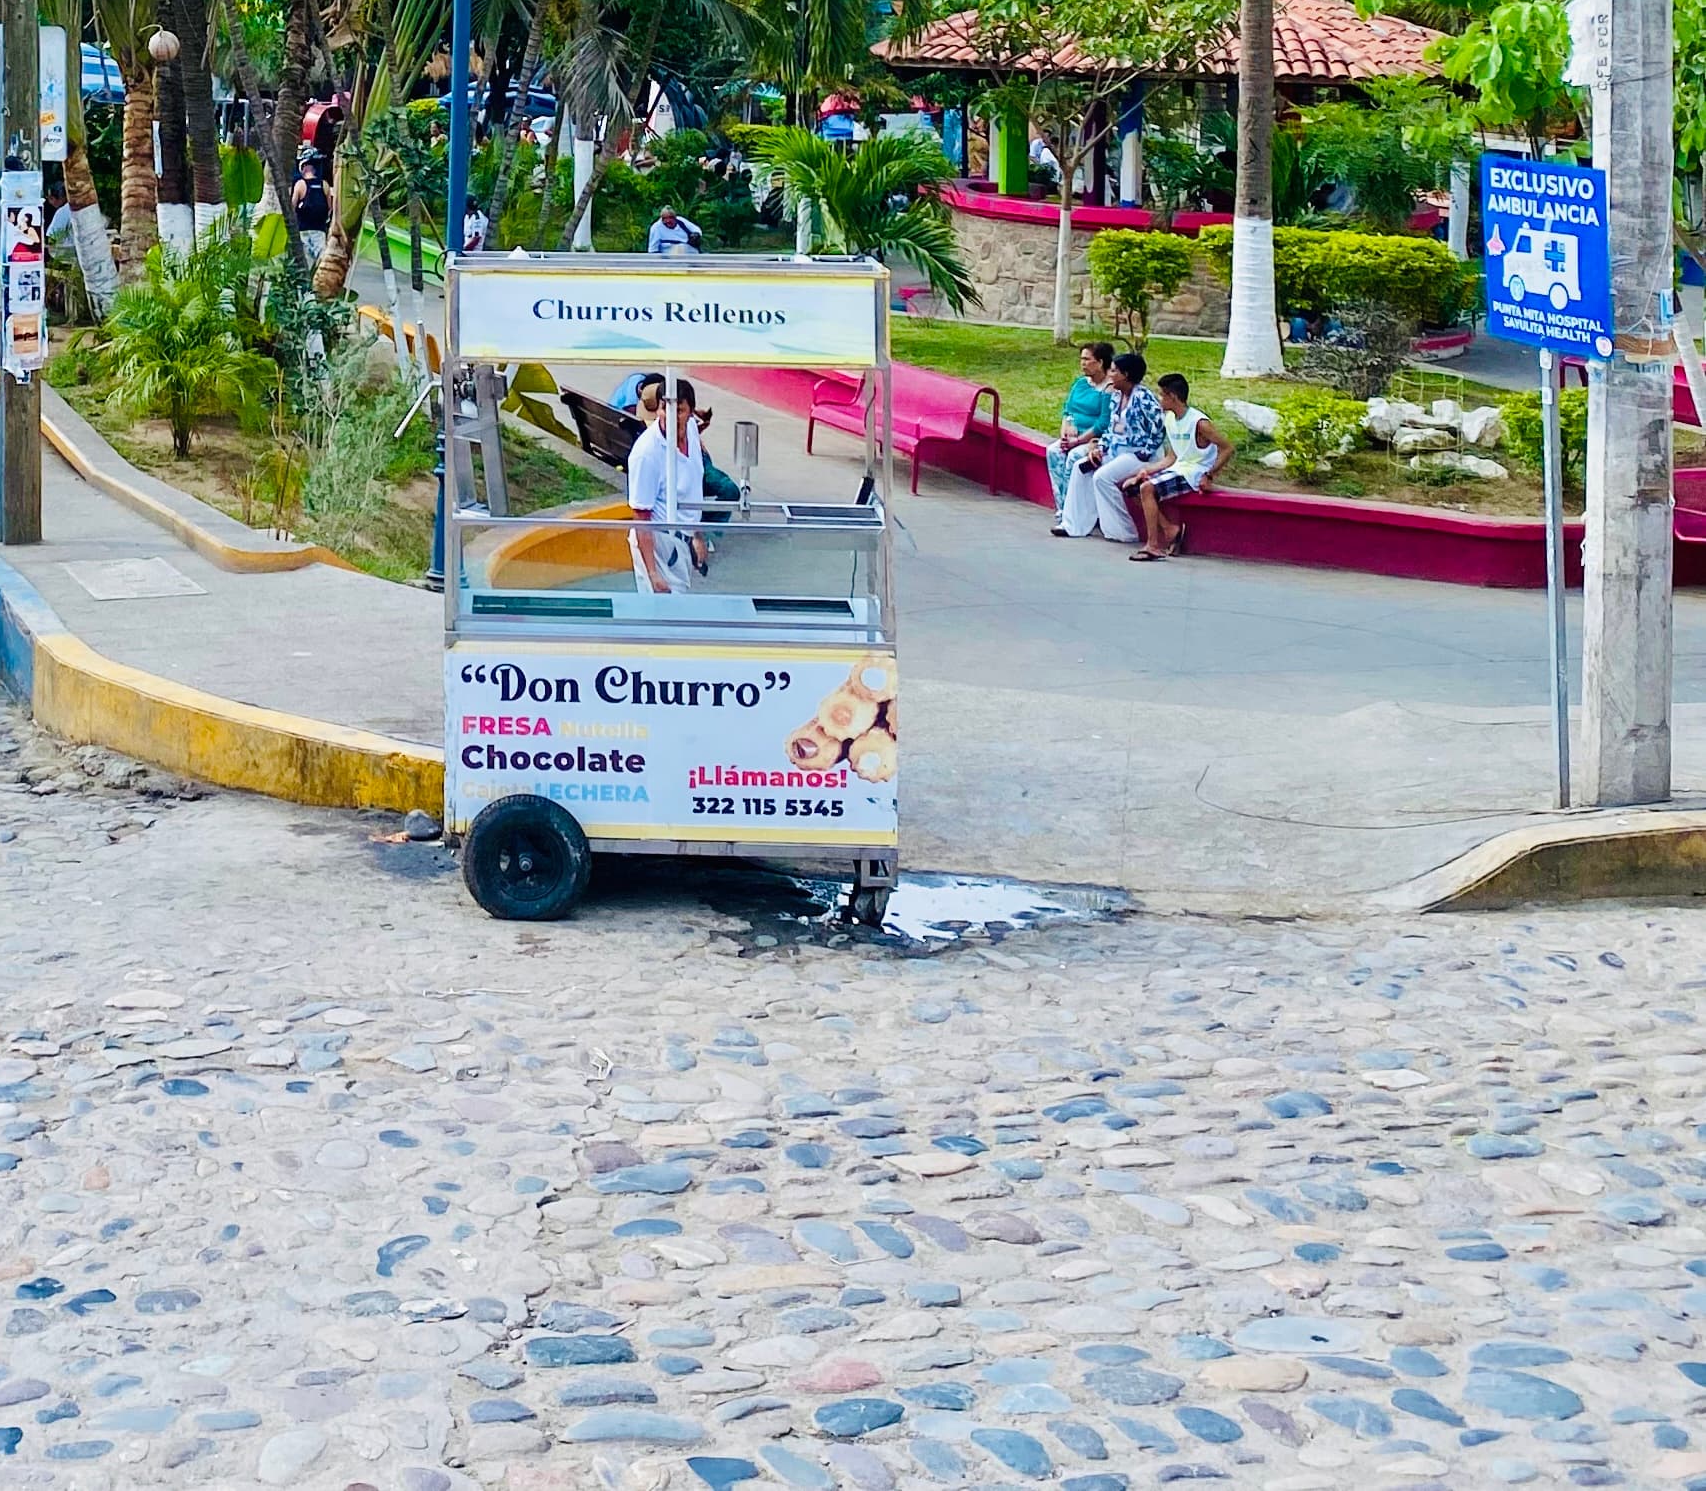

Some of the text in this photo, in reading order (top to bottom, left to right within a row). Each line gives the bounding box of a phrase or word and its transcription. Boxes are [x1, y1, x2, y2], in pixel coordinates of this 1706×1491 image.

[1489, 167, 1595, 200] EXCLUSIVO
[1487, 194, 1599, 227] AMBULANCIA
[532, 298, 786, 325] Churros Rellenos
[1492, 300, 1604, 333] PUNTA MITA HOSPITAL
[1503, 315, 1592, 344] SAYULITA HEALTH
[462, 715, 649, 739] FRESA Nutella
[461, 744, 646, 774] Chocolate
[689, 765, 848, 789] ¡Llámanos!
[534, 782, 650, 803] LECHERA
[692, 797, 844, 817] 322 115 5345
